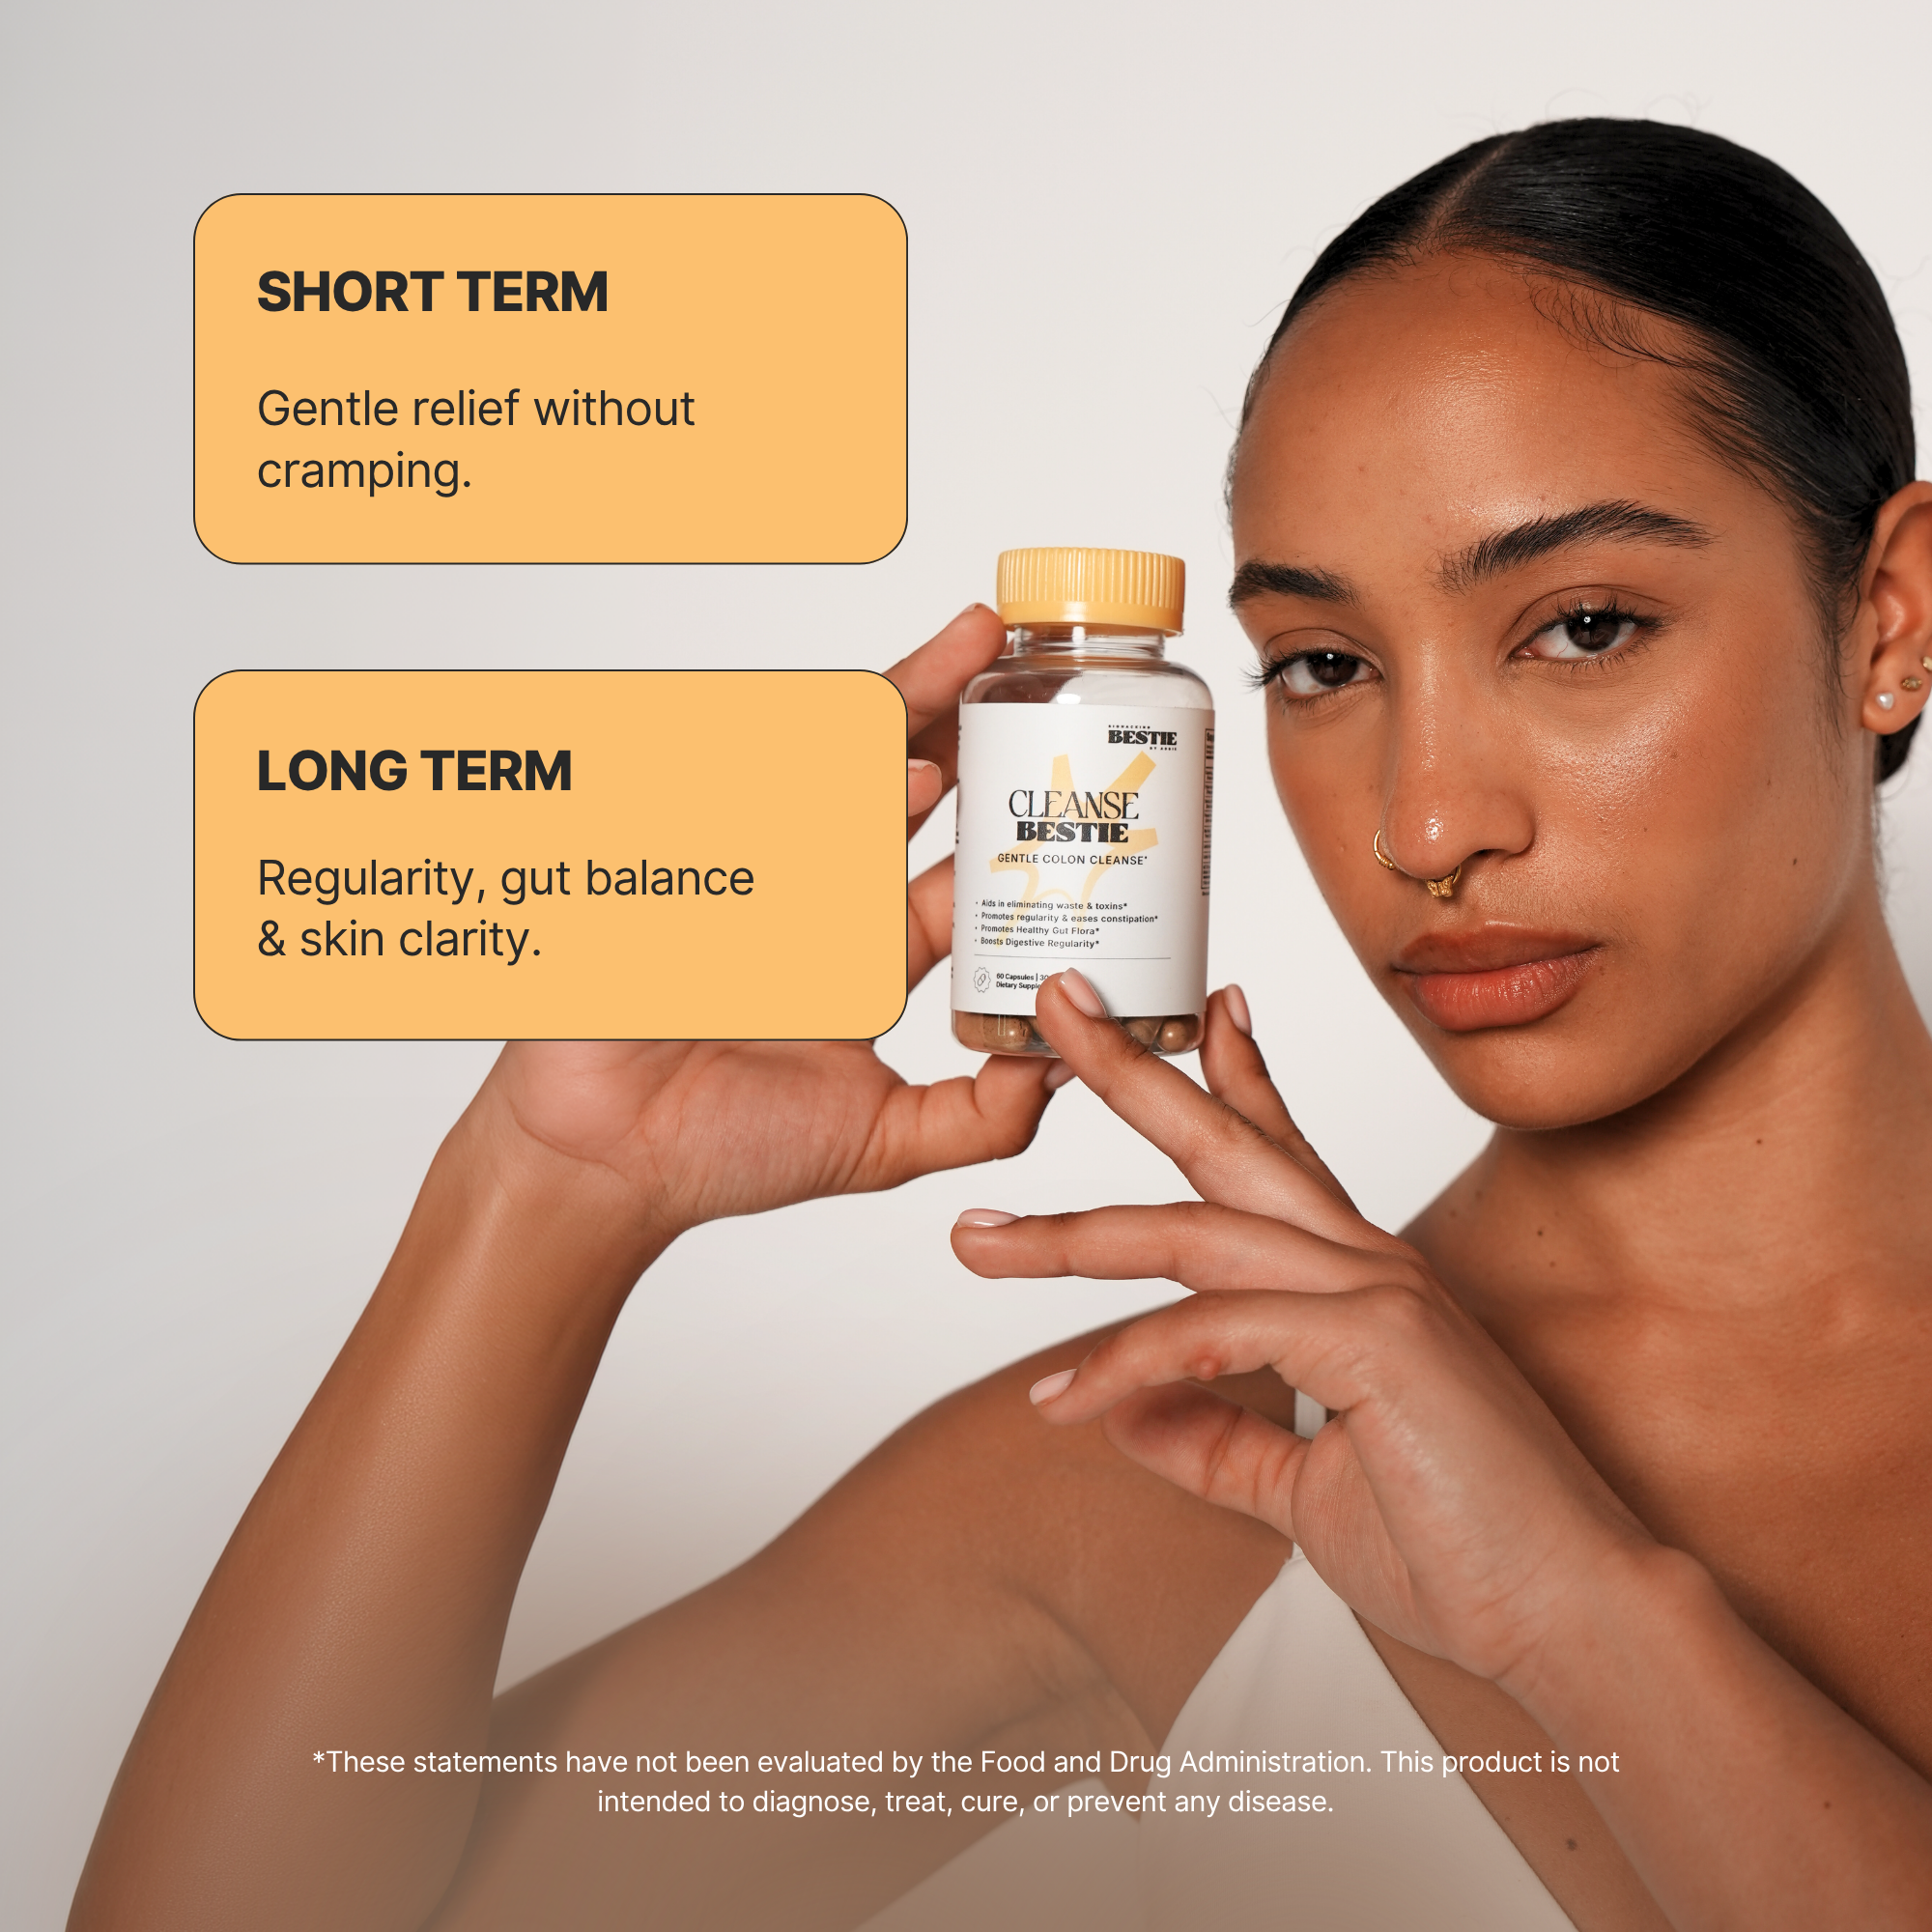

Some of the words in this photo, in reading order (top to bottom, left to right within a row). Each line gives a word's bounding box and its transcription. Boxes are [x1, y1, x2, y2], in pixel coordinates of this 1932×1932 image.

[1108, 730, 1178, 746] BESTIE
[1009, 789, 1139, 819] CLEANSE
[1016, 821, 1129, 843] BESTIE
[997, 853, 1038, 864] GENTLE
[1042, 854, 1085, 865] COLON
[1007, 900, 1054, 910] eliminating
[981, 912, 1014, 921] Promotes
[1016, 913, 1059, 923] regularity
[980, 924, 1013, 933] Promotes
[1016, 925, 1049, 935] Healthy
[980, 937, 1004, 946] Boosts
[1006, 938, 1044, 948] Digestive
